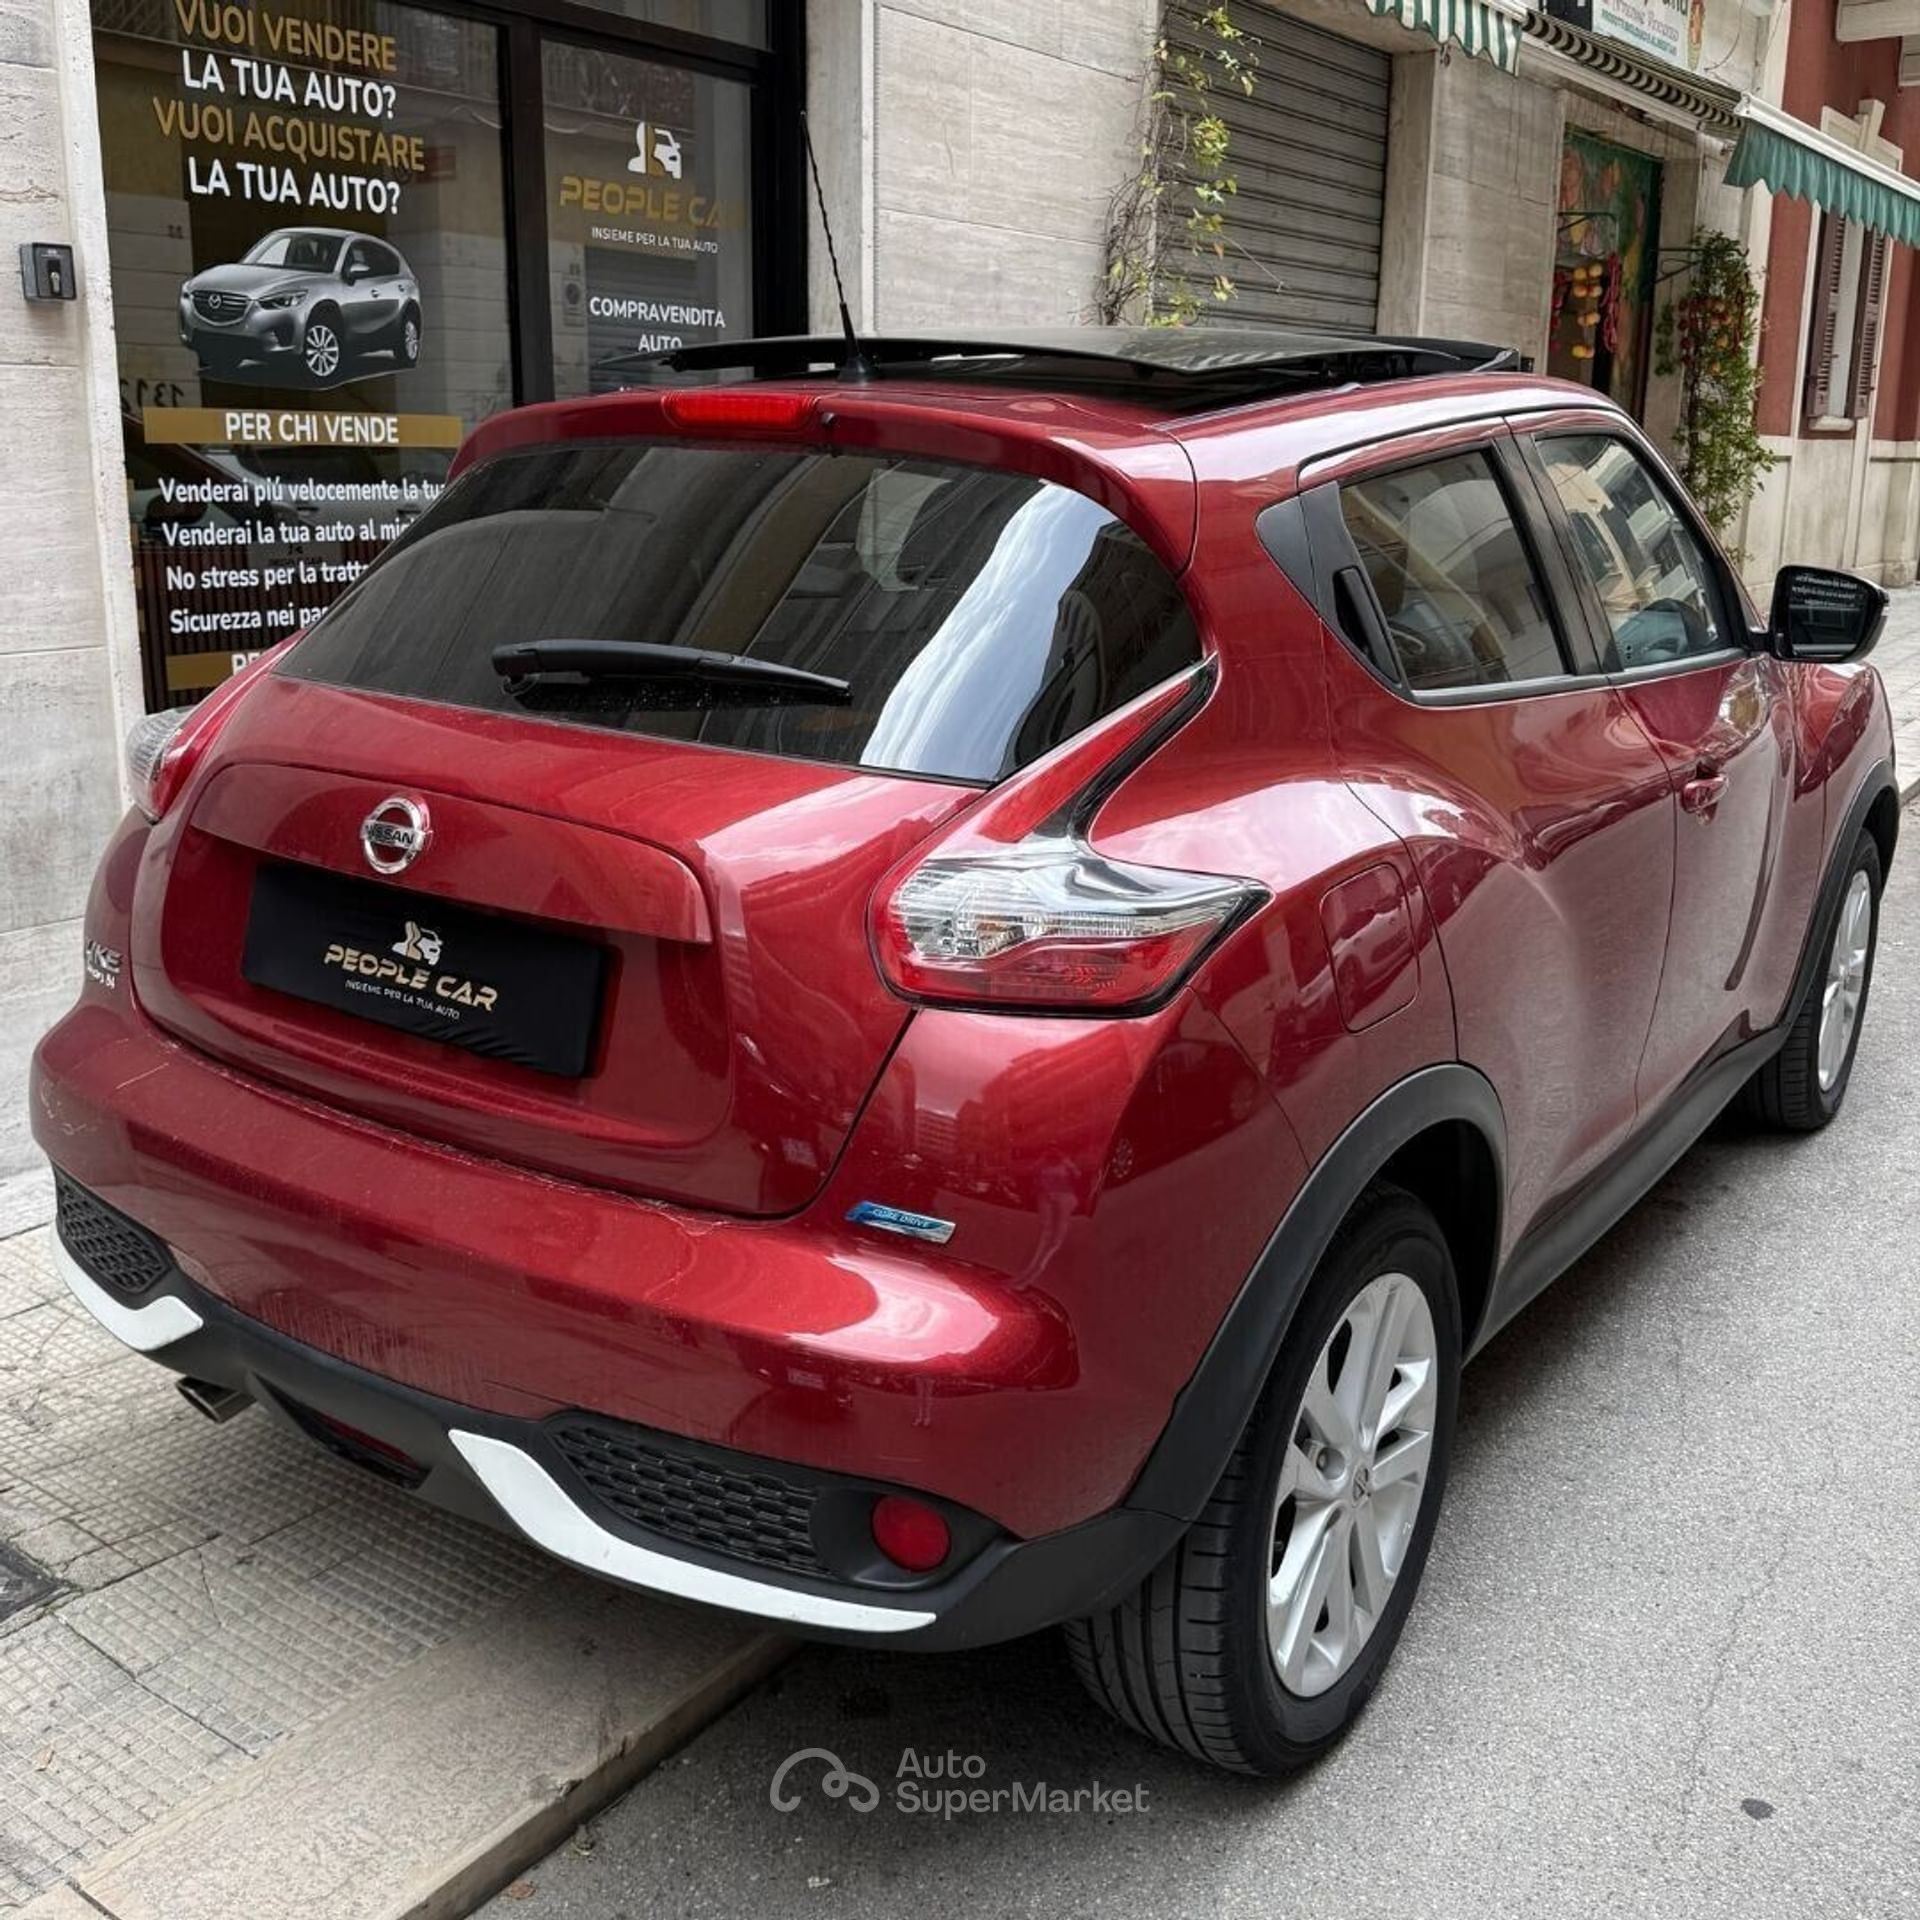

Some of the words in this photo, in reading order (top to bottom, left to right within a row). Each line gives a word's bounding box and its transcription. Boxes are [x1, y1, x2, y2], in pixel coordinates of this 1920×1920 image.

[176, 0, 255, 45] VUOI
[262, 12, 398, 72] VENDERE
[182, 50, 225, 93] LA
[231, 57, 295, 101] TUA
[304, 71, 397, 119] AUTO?
[153, 97, 235, 145] VUOI
[243, 112, 425, 172] ACQUISTARE
[189, 156, 231, 197] LA
[236, 163, 301, 205] TUA
[308, 172, 401, 215] AUTO?
[560, 175, 680, 222] PEOPLE
[688, 197, 738, 229] CA
[592, 227, 633, 243] INSIEME
[636, 232, 655, 246] PER
[658, 235, 670, 247] LA
[671, 237, 691, 250] TUA
[693, 241, 718, 254] AUTO
[590, 297, 726, 328] COMPRAVENDITA
[638, 334, 682, 353] AUTO
[225, 412, 272, 441] PER
[279, 414, 318, 442] CHI
[324, 415, 400, 444] VENDE
[158, 477, 249, 503] Venderai
[288, 478, 398, 502] velocemente
[402, 478, 418, 500] la
[162, 521, 251, 547] Venderai
[256, 519, 278, 544] la
[279, 522, 309, 543] tua
[315, 521, 355, 543] auto
[359, 517, 376, 541] al
[166, 566, 195, 590] No
[201, 566, 259, 588] stress
[264, 565, 295, 591] per
[300, 560, 316, 583] la
[170, 609, 261, 634] Sicurezza
[267, 602, 294, 627] nei
[365, 823, 415, 845] NISSAN
[324, 944, 431, 988] PEOPLE
[435, 975, 498, 1012] CAR
[345, 979, 381, 995] INSIEME
[384, 988, 401, 1001] PER
[403, 993, 414, 1005] LA
[416, 997, 434, 1012] TUA
[435, 1001, 460, 1020] AUTO
